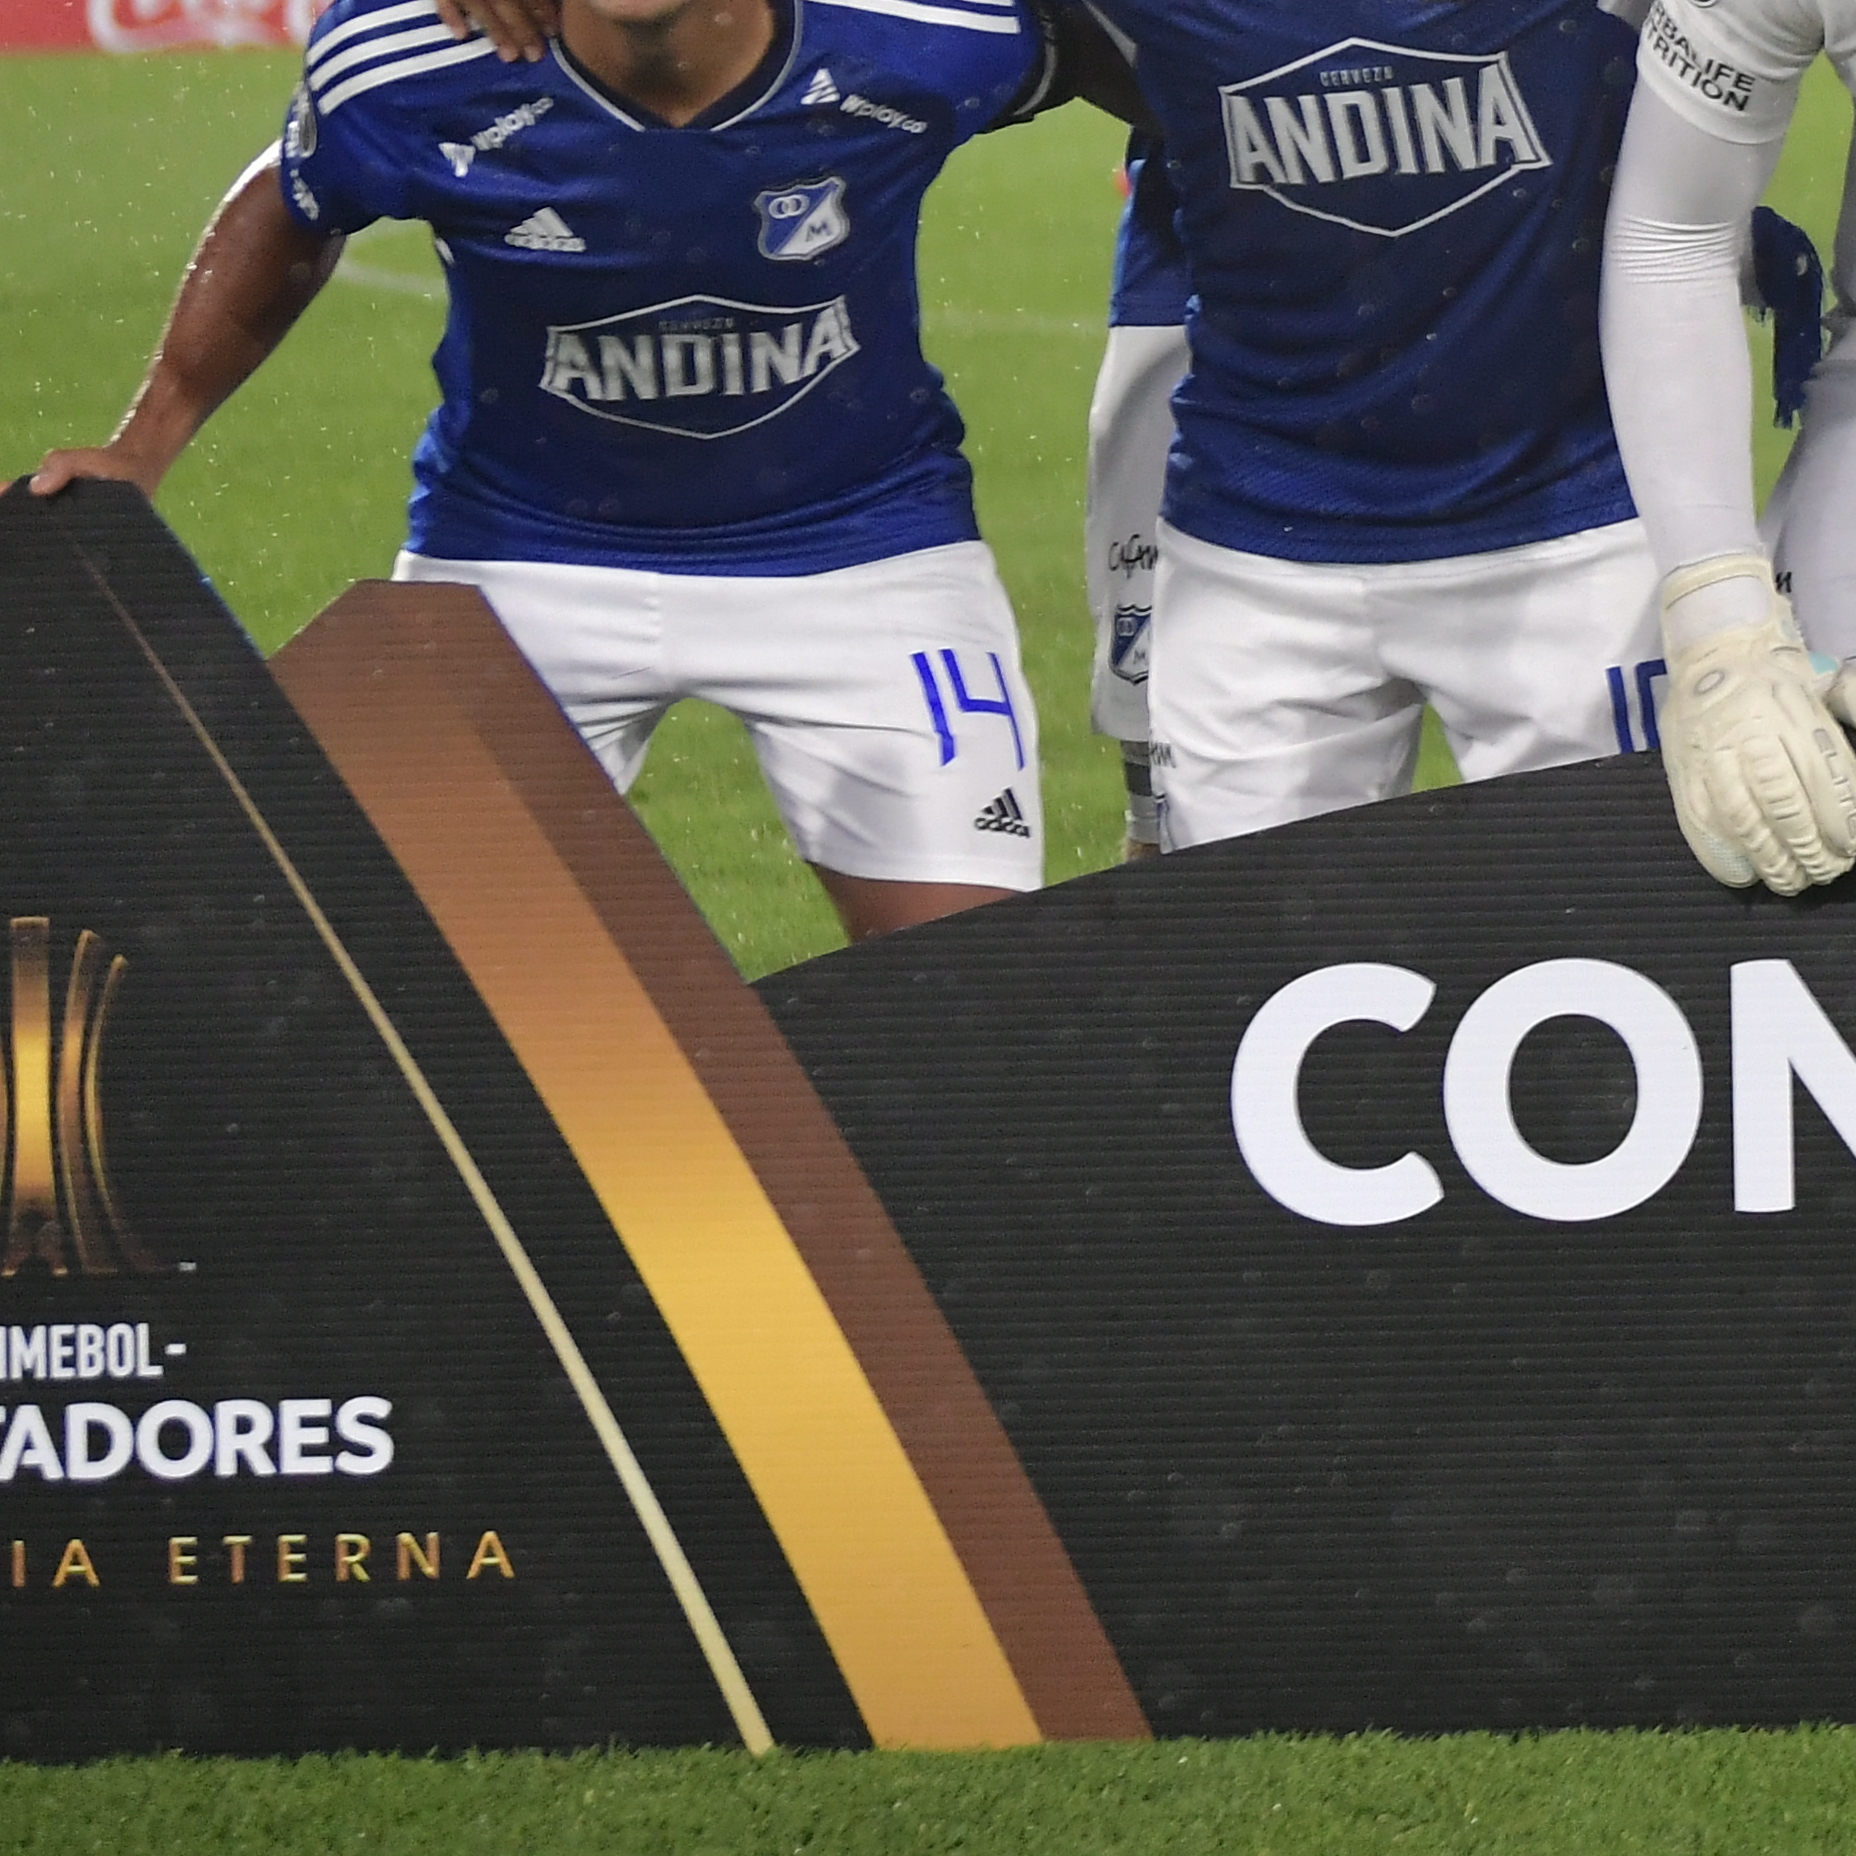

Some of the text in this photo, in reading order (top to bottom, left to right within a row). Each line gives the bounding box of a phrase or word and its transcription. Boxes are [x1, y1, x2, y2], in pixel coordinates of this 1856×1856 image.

[1319, 65, 1393, 88] CERVEZA
[1653, 0, 1755, 94] RBALIFE
[1229, 63, 1524, 186] ANDINA
[550, 300, 852, 402] ANDINA
[910, 647, 1025, 771] 14
[0, 1395, 395, 1482] ADORES
[167, 1530, 516, 1585] ETERNA
